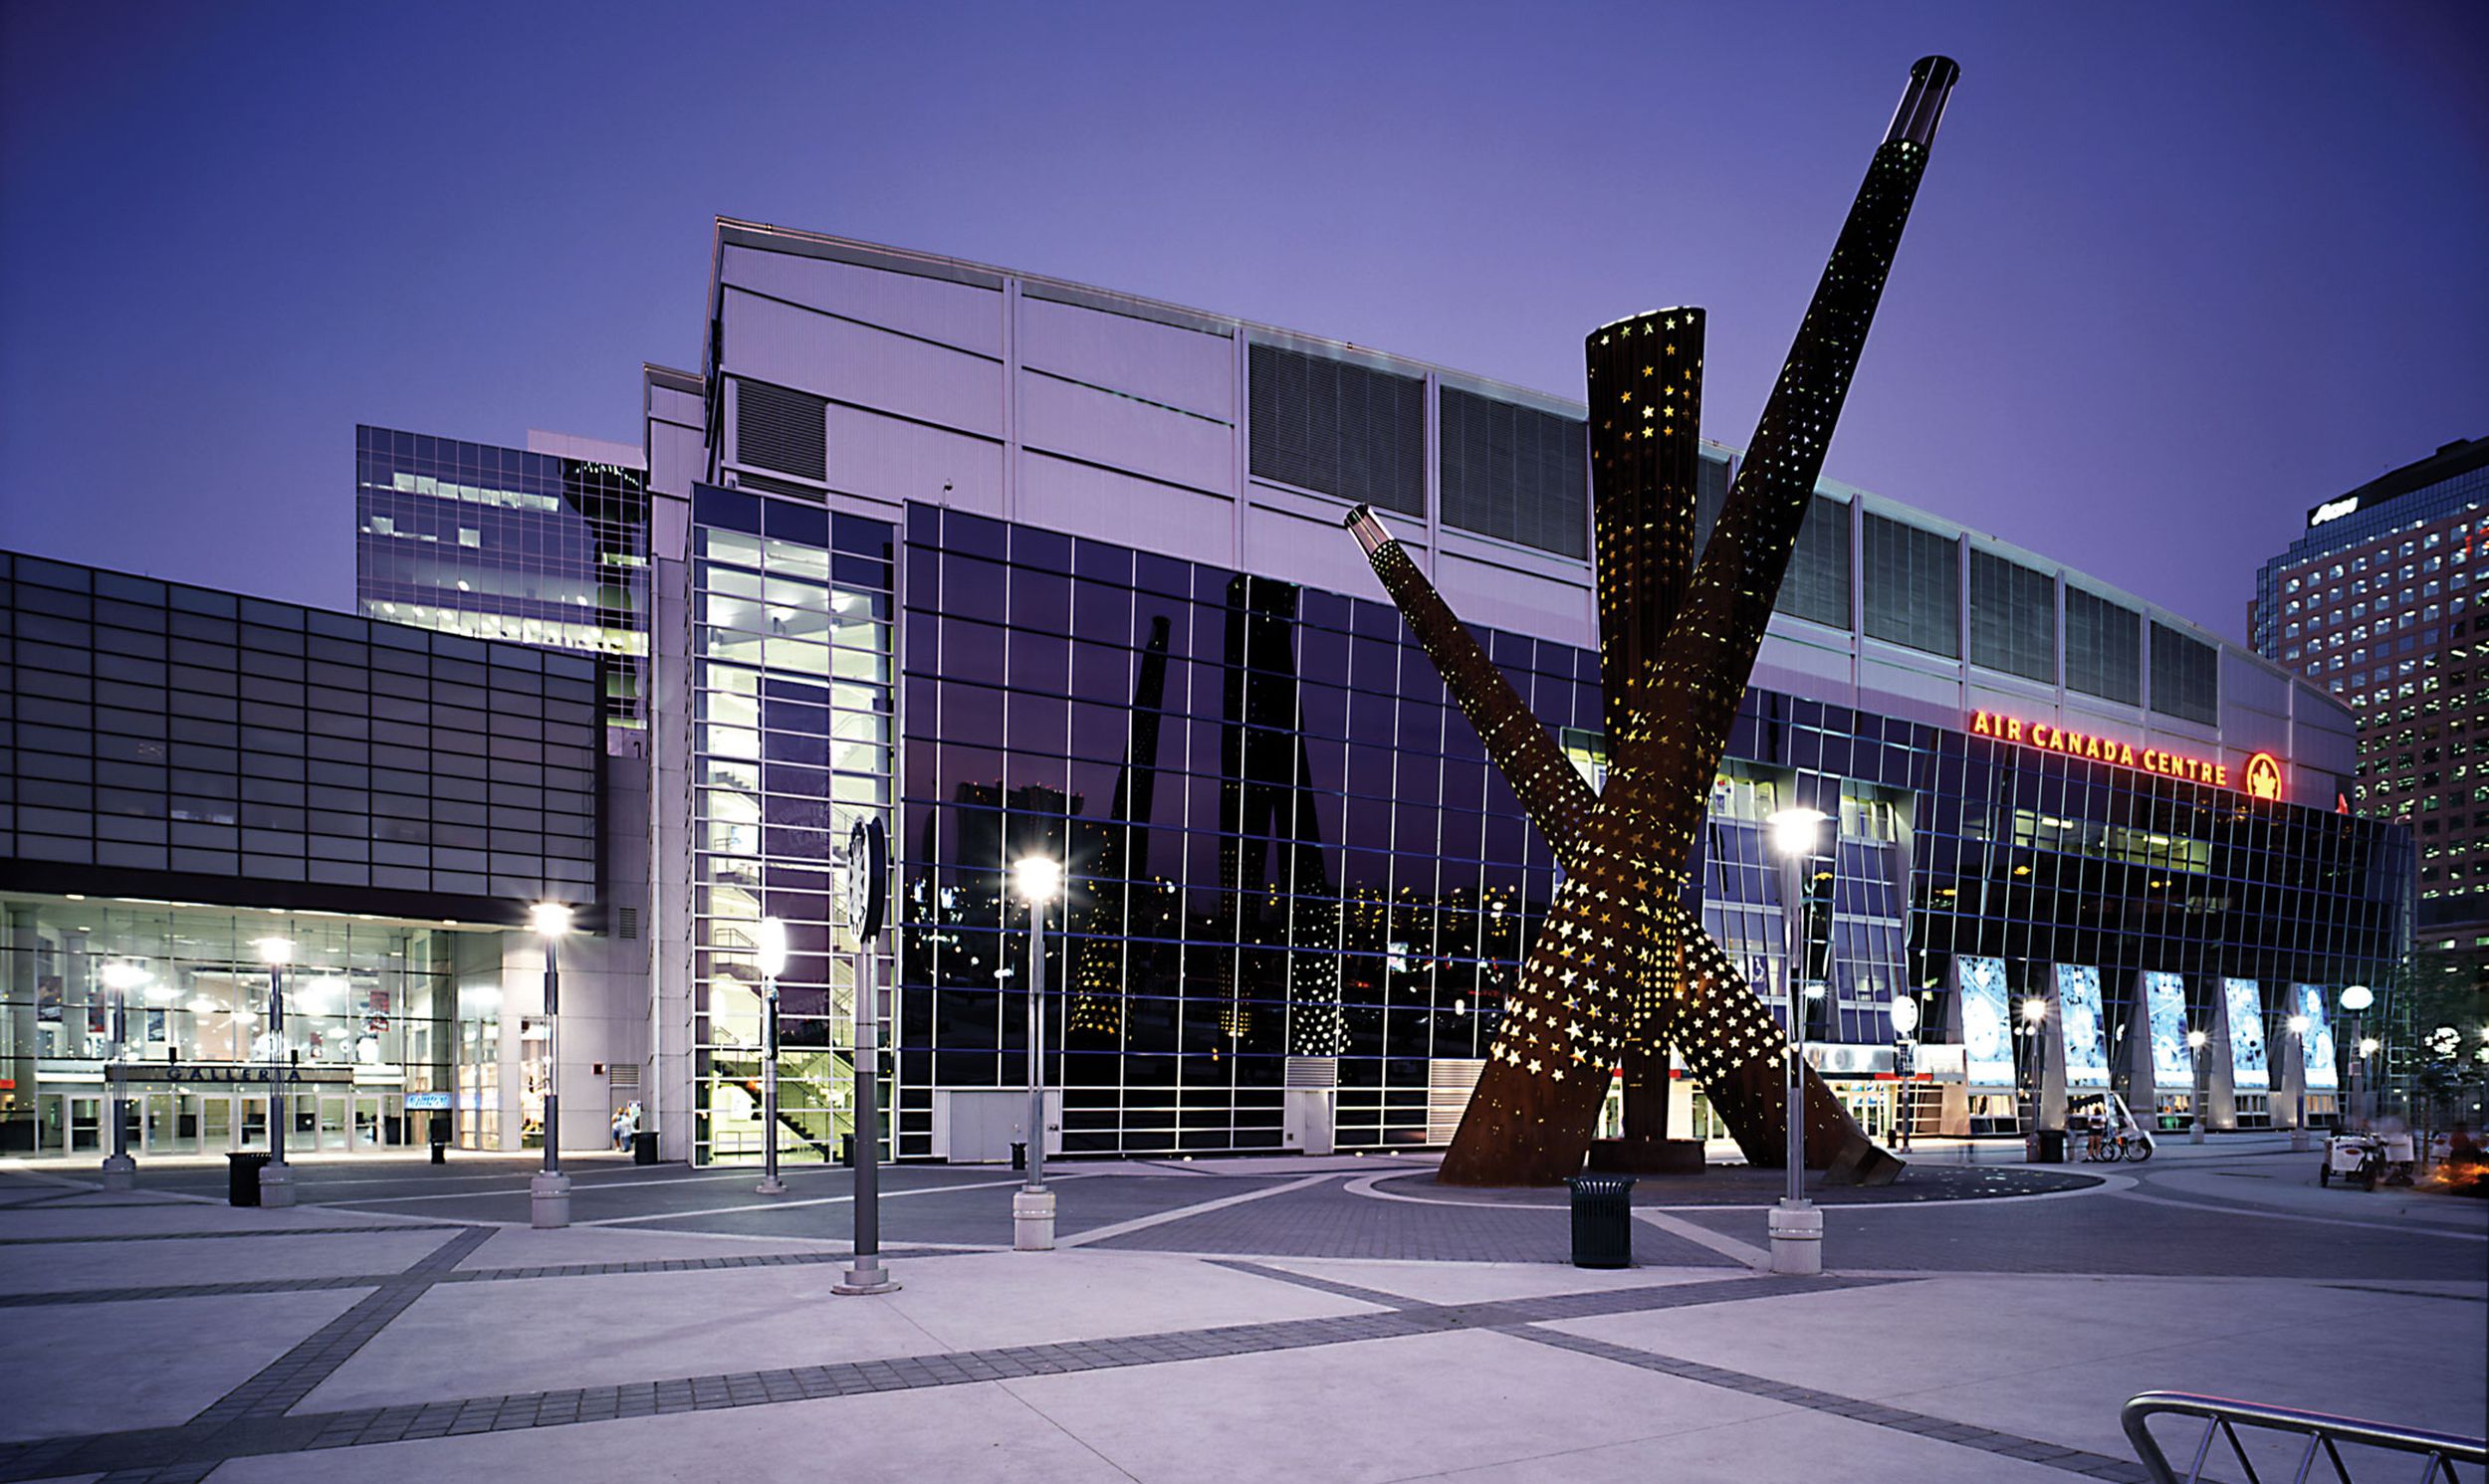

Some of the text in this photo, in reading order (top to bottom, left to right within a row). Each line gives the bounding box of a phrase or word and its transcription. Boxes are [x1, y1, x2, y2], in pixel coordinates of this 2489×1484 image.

[1974, 711, 2227, 786] AIR CANADA CENTRE
